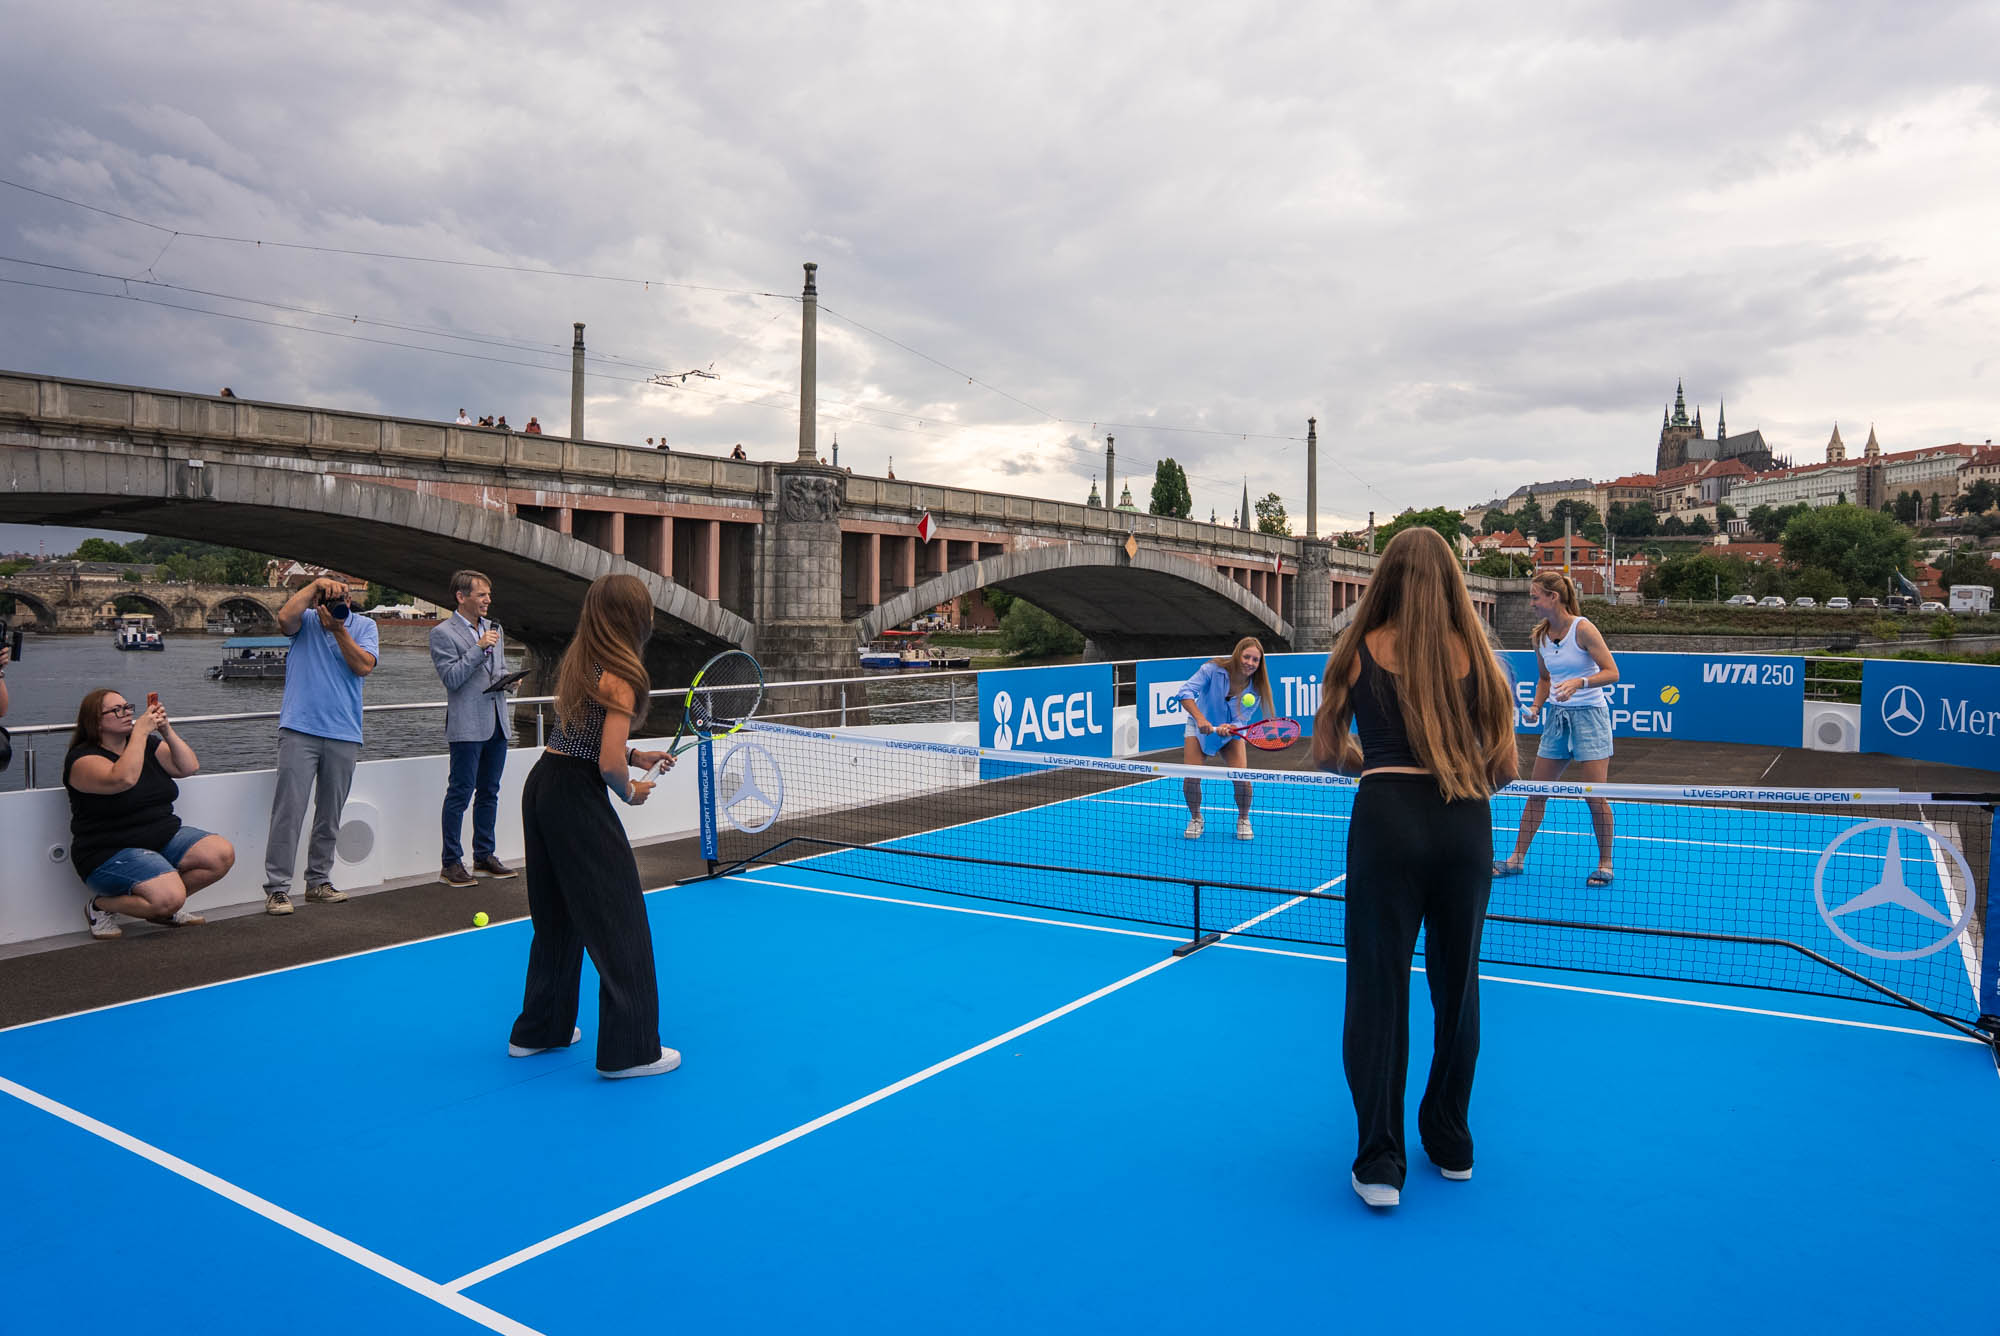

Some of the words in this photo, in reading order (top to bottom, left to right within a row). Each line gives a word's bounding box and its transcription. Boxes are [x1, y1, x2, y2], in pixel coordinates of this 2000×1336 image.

[1703, 663, 1757, 685] WTA
[1761, 664, 1794, 686] 250
[1015, 691, 1103, 746] AGEL
[1612, 709, 1673, 733] PEN
[750, 723, 785, 734] LIVESPORT
[786, 727, 812, 738] PRAGUE
[812, 731, 831, 740] OPEN
[885, 740, 926, 751] LIVESPORT
[927, 744, 957, 754] PRAGUE
[958, 747, 979, 757] OPEN
[1043, 756, 1091, 767] LIVESPORT
[1092, 760, 1126, 771] PRAGUE
[1128, 764, 1152, 773] OPEN
[702, 769, 711, 804] PRAGUE
[1227, 771, 1281, 781] LIVESPORT
[1283, 774, 1323, 784] PRAGUE
[1325, 776, 1352, 785] OPEN
[1504, 784, 1549, 793] PRAGUE
[1552, 785, 1583, 794] OPEN
[1683, 788, 1755, 799] LIVESPORT
[1758, 791, 1810, 801] PRAGUE
[1814, 792, 1850, 802] OPEN
[705, 807, 713, 856] LIVESPORT
